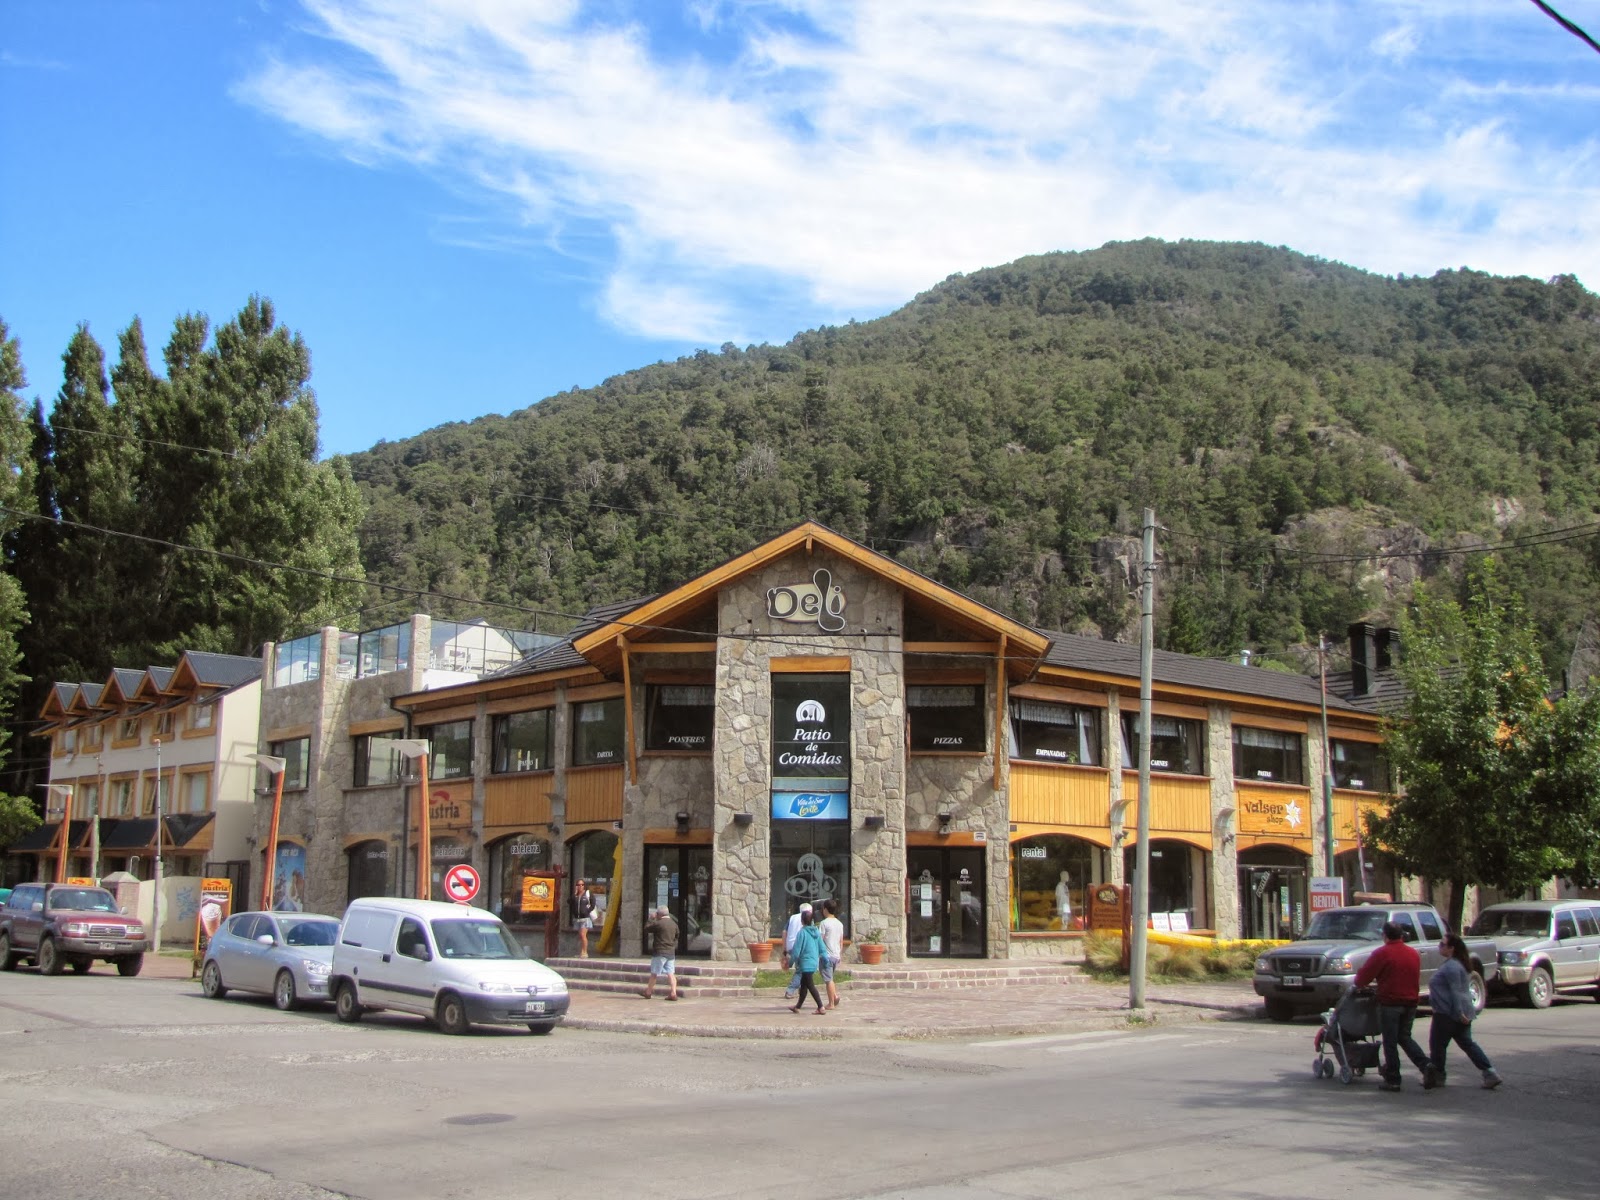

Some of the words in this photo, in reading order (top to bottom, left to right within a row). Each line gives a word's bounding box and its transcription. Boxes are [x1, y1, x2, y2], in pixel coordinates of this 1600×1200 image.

[767, 568, 845, 631] Deli
[793, 728, 831, 741] Patio
[805, 742, 818, 751] de
[779, 752, 842, 765] Comidas
[1036, 749, 1066, 758] EMPANADAS
[797, 798, 808, 806] Villa
[429, 801, 460, 819] ustria
[1266, 815, 1284, 825] shop
[1021, 847, 1046, 858] rental
[1312, 895, 1339, 908] RENTAL
